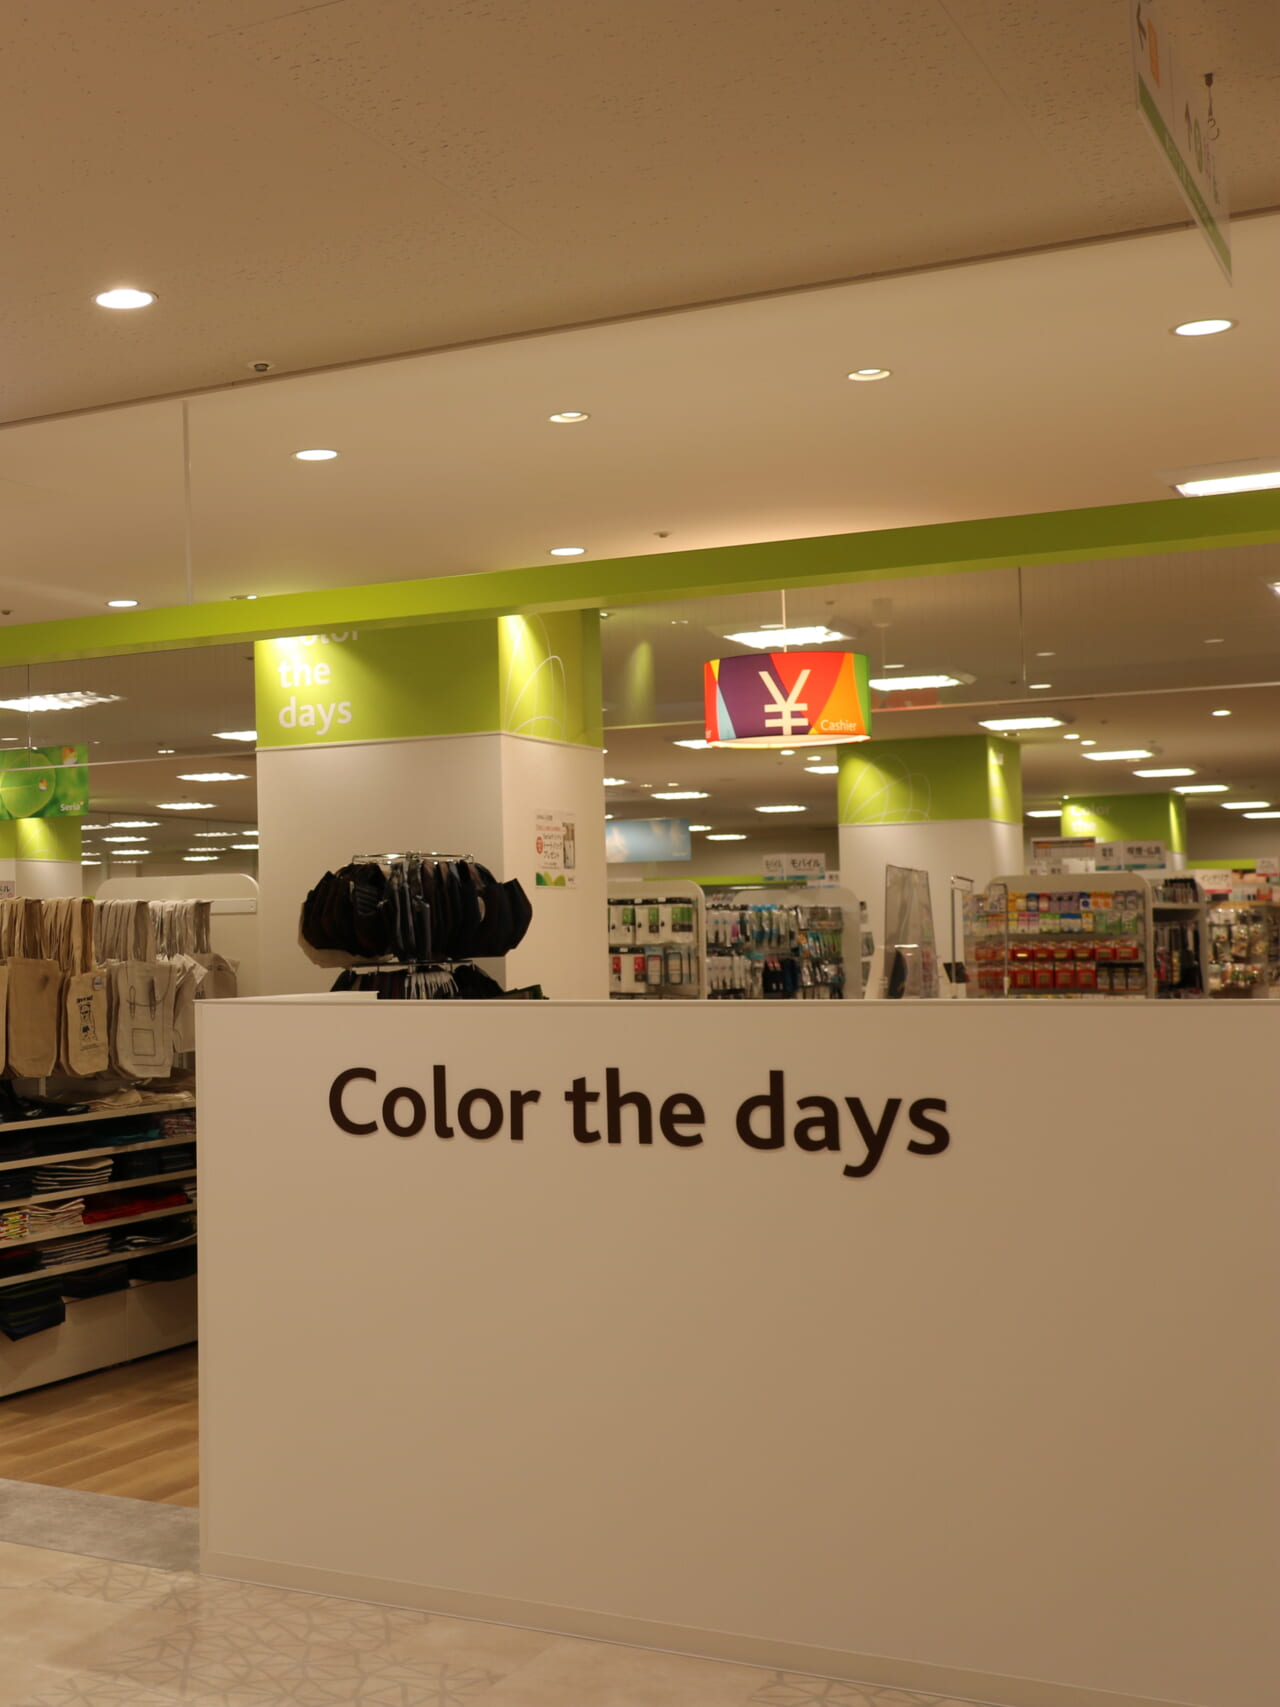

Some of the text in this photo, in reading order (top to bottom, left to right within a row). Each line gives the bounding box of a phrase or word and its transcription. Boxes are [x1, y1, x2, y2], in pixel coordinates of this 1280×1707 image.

[277, 656, 331, 688] the
[278, 695, 353, 735] days
[820, 719, 857, 731] Cashier
[59, 802, 81, 812] Seria
[790, 857, 821, 868] モバイル
[328, 1064, 952, 1178] Color the days
